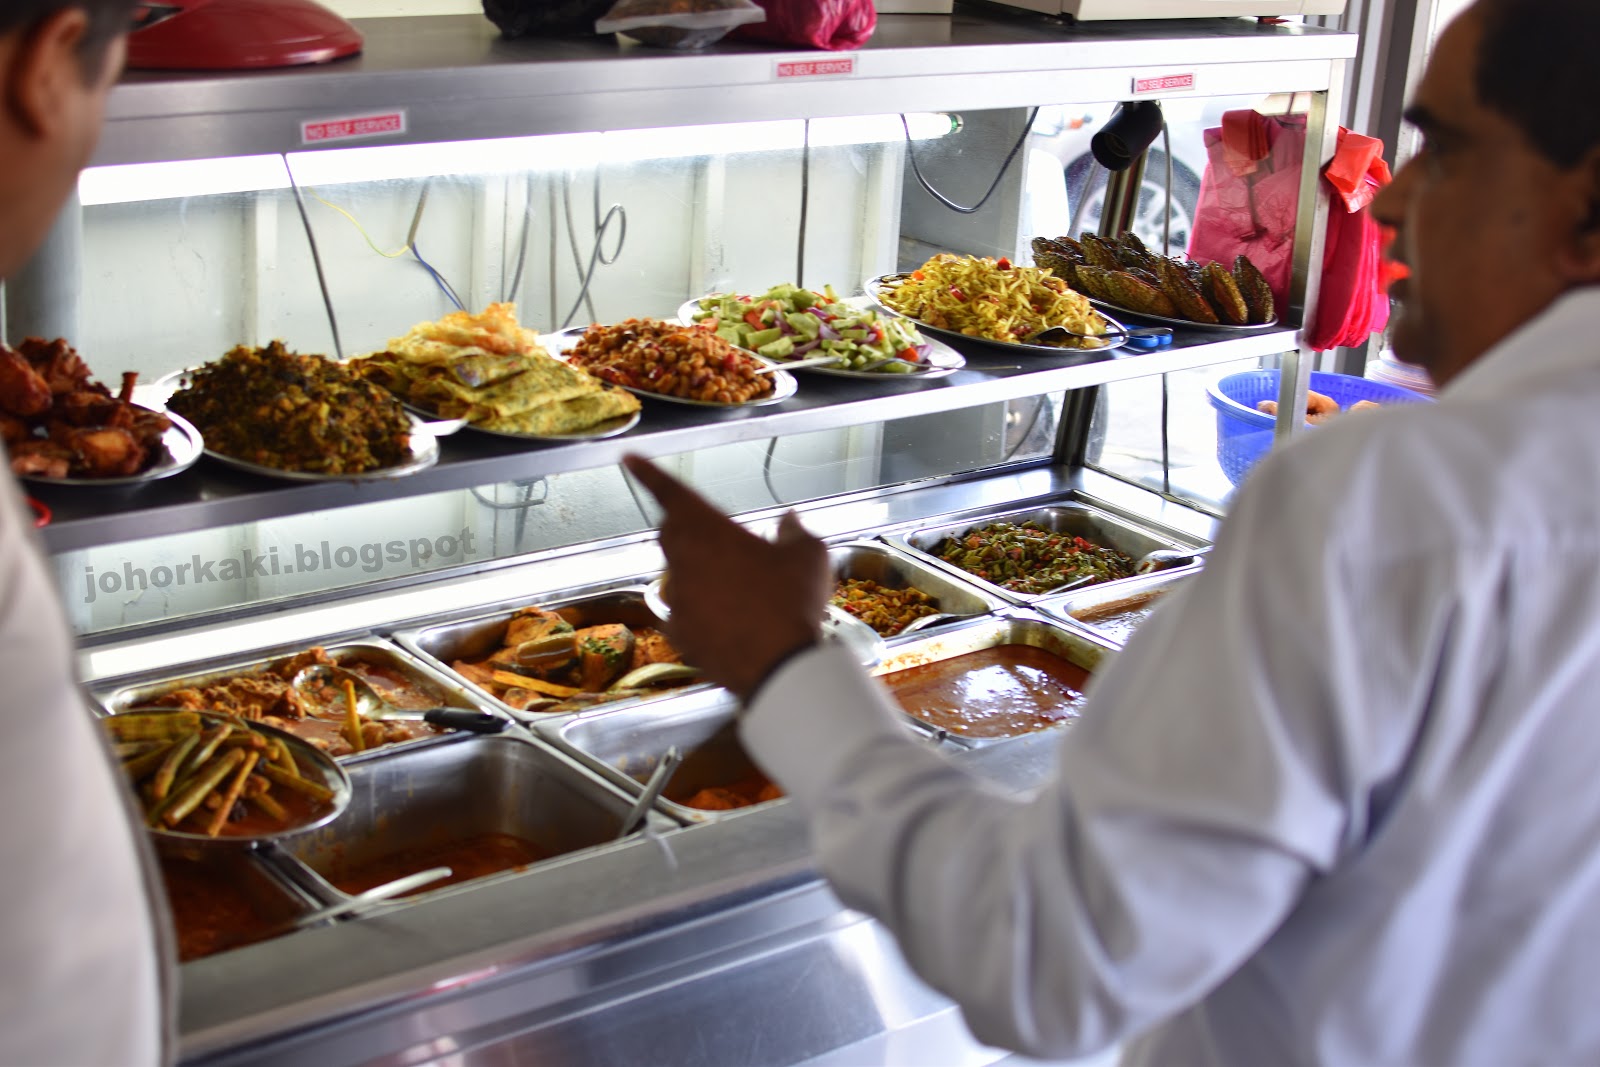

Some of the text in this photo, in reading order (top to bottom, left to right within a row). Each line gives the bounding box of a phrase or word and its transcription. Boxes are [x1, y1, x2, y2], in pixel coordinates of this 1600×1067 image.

[779, 60, 851, 76] NO SELF SERVICE
[1138, 76, 1192, 91] NO SELF SERVICE
[307, 116, 399, 139] NO SELF SERVICE
